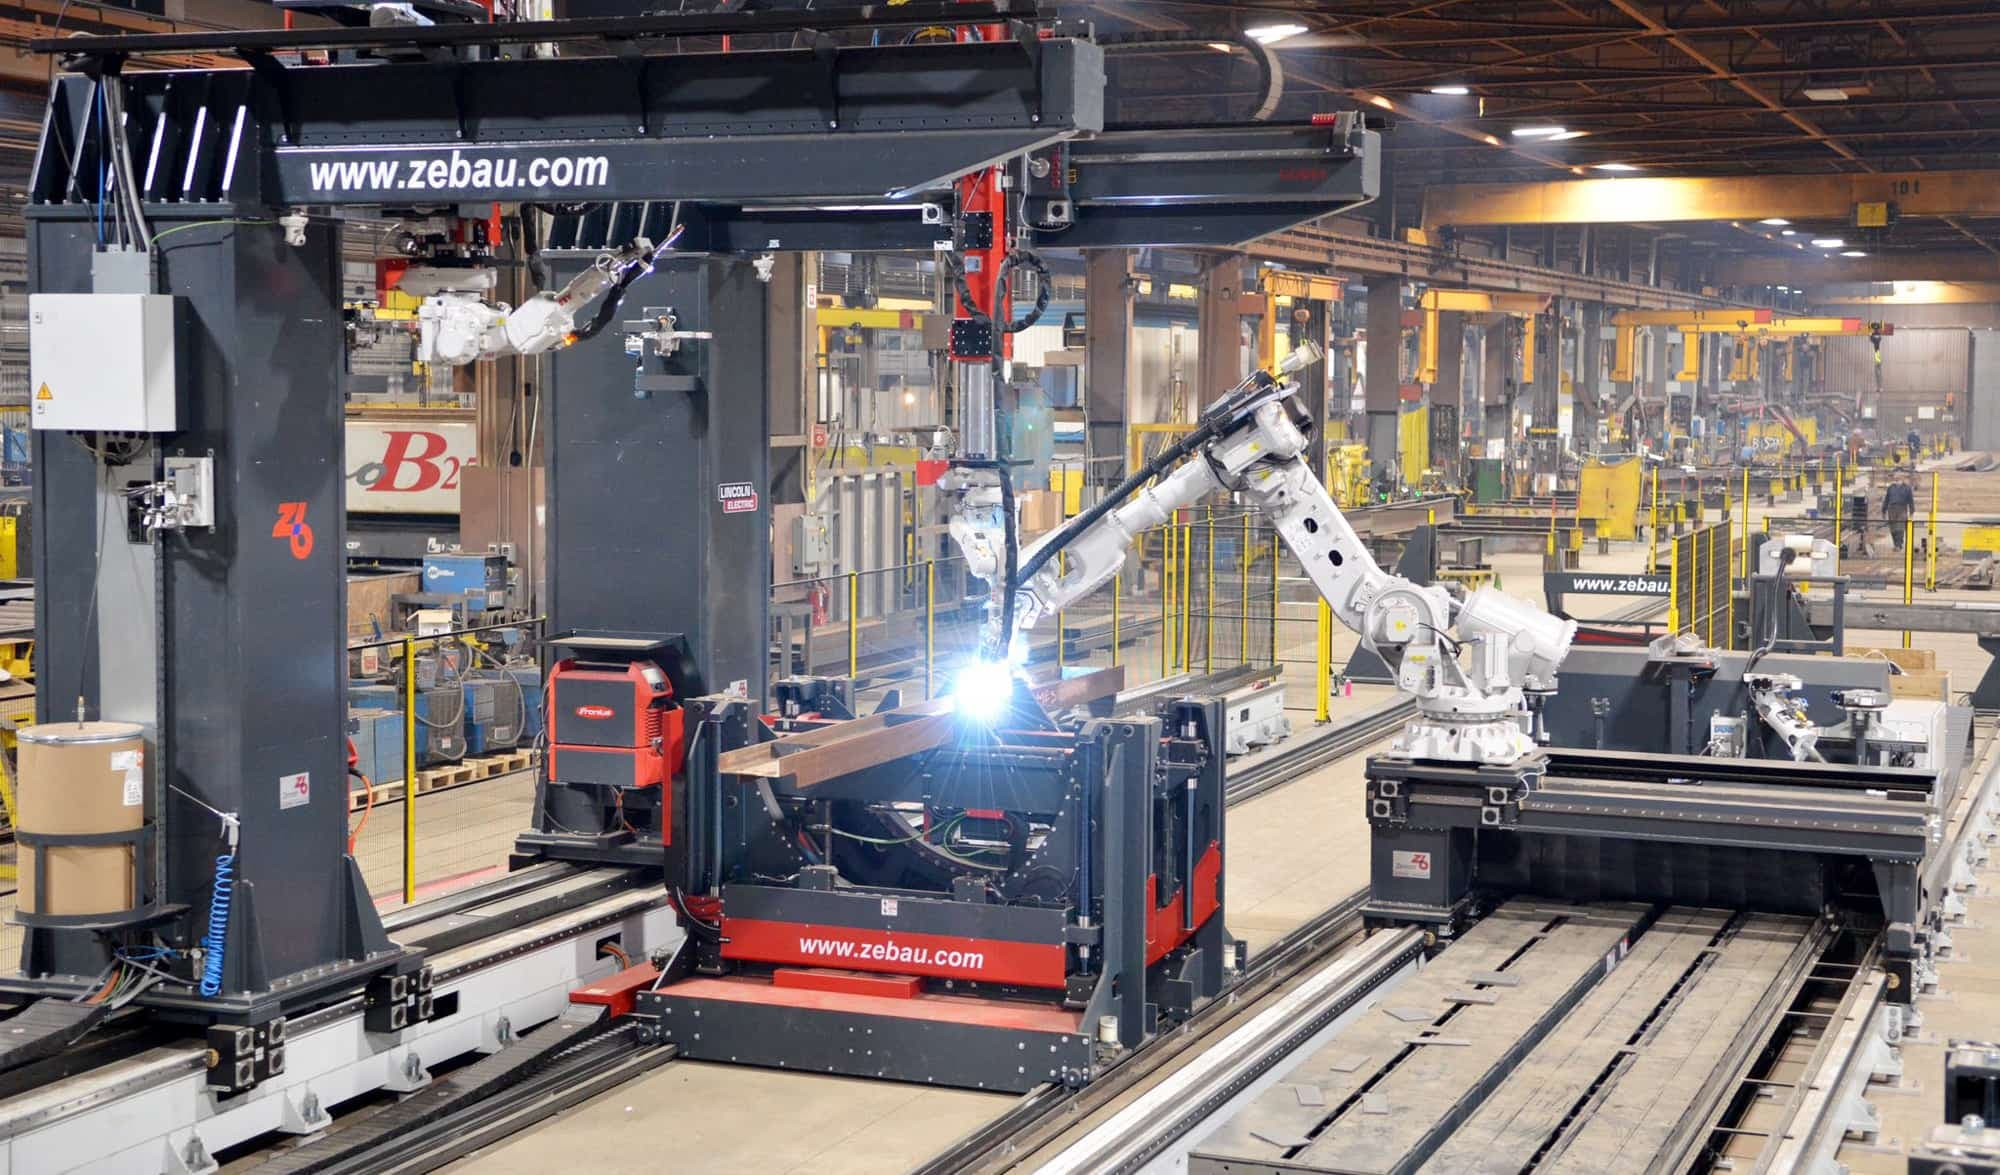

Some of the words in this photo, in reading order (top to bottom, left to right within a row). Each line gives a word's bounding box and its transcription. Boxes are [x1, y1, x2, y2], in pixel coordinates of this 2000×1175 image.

[310, 150, 609, 190] www.zebau.com
[720, 485, 751, 498] LINCOLN
[800, 937, 984, 968] www.zebau.com
